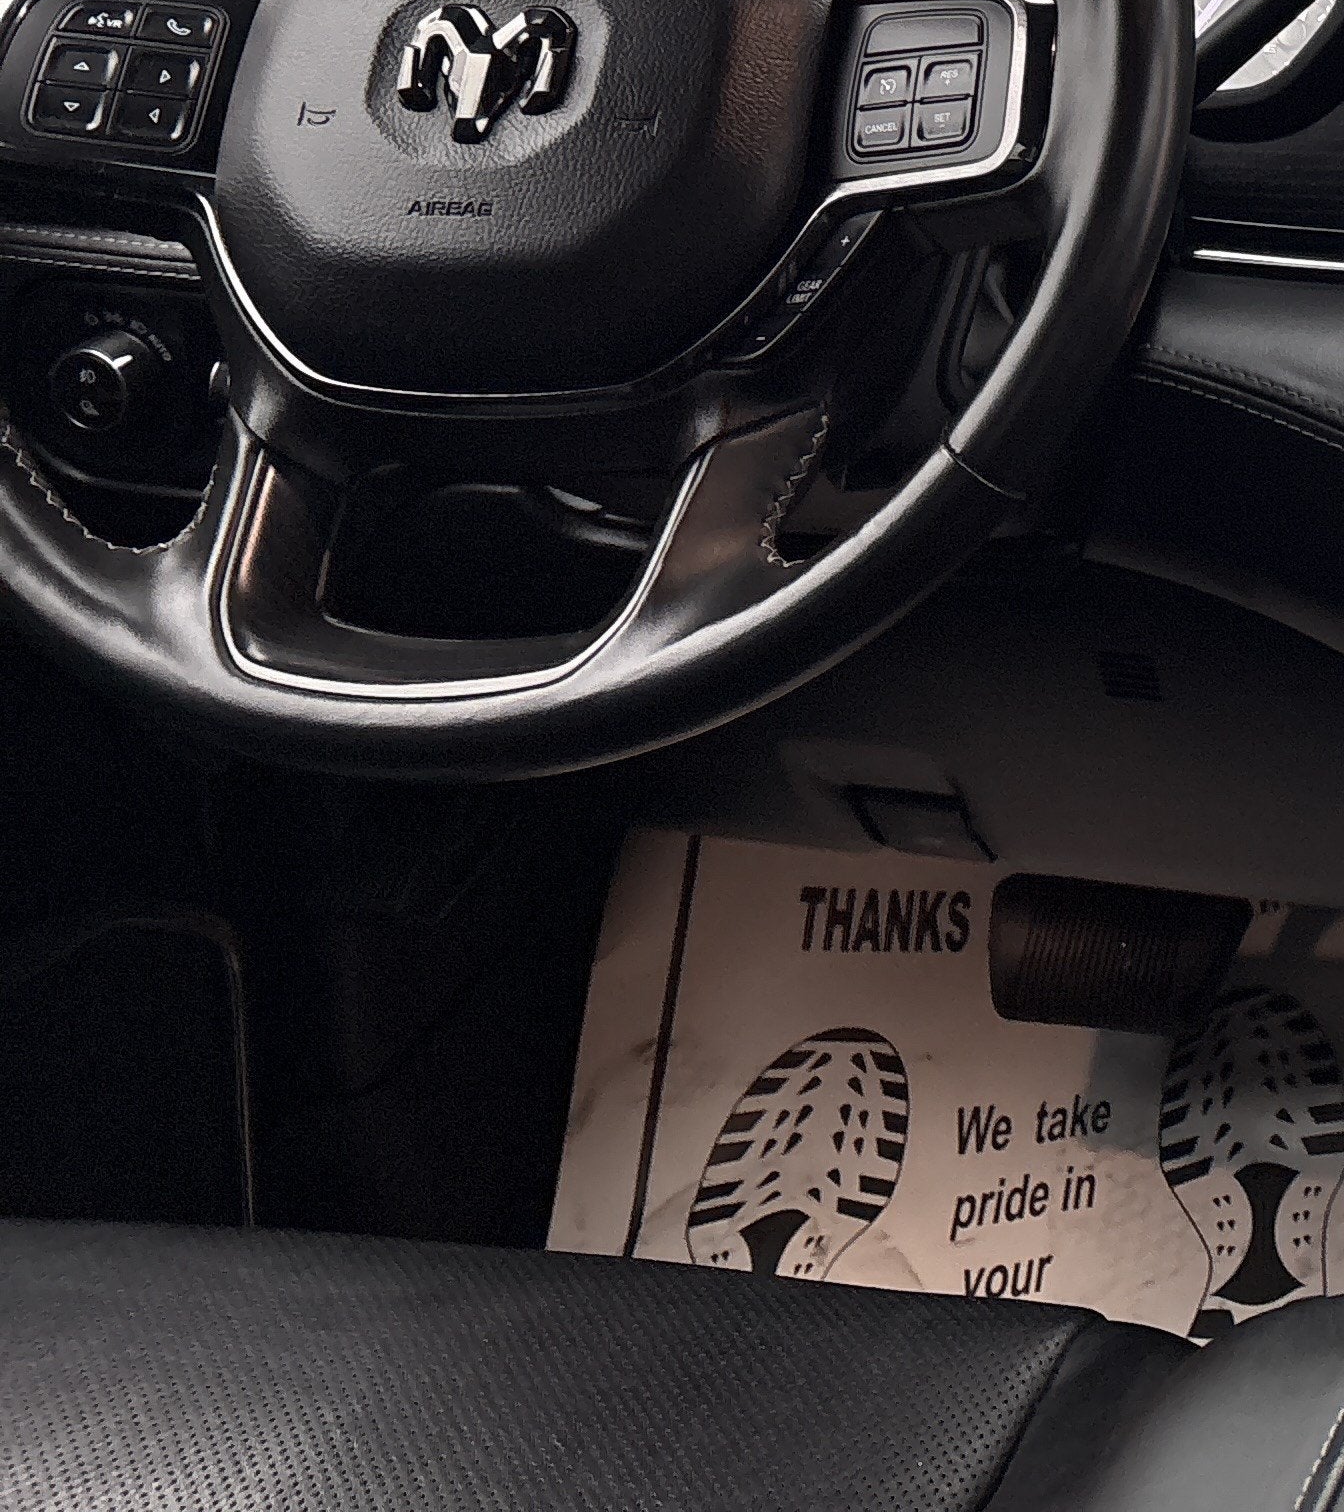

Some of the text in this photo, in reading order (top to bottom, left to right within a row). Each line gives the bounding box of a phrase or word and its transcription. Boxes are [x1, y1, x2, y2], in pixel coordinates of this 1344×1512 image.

[106, 18, 123, 29] VR
[940, 69, 959, 79] RES
[933, 112, 951, 123] SET
[864, 121, 898, 135] CANCEL
[406, 199, 494, 218] AIRBAG
[799, 885, 972, 955] THANKS
[957, 1093, 1112, 1156] We take
[949, 1164, 1096, 1242] pride in
[964, 1253, 1054, 1298] your
